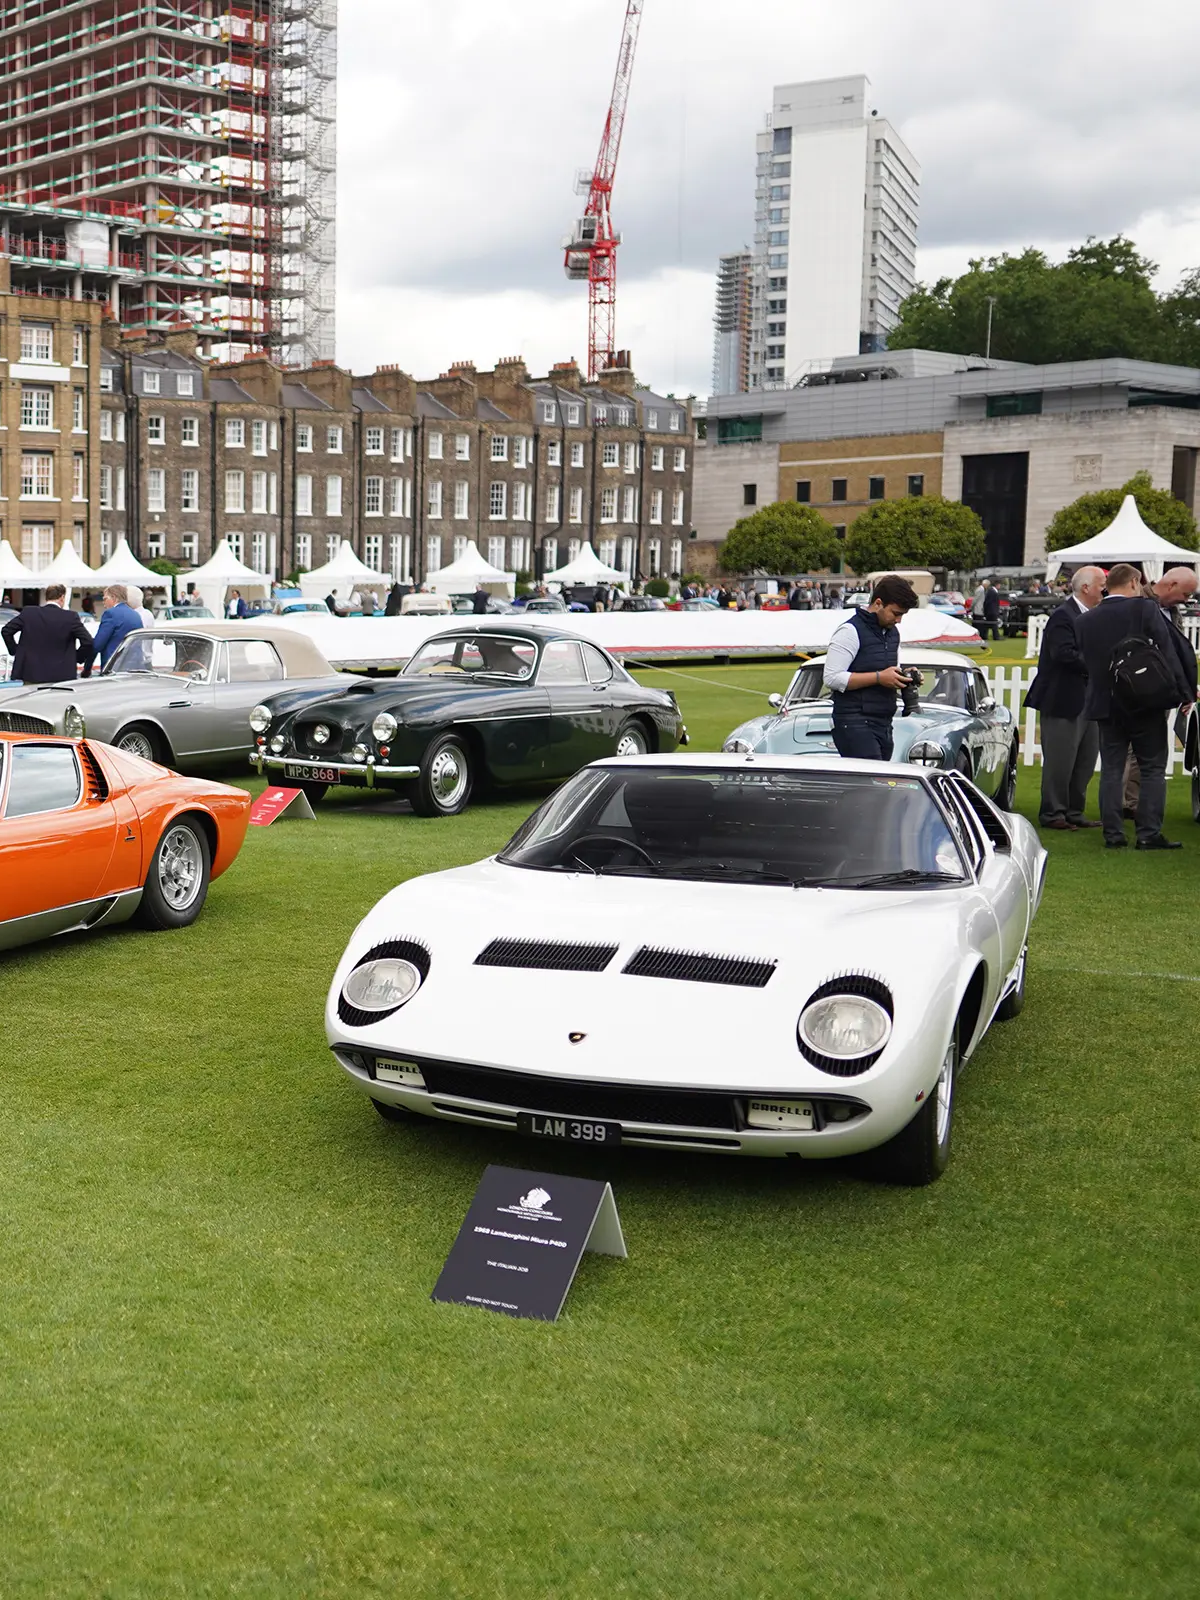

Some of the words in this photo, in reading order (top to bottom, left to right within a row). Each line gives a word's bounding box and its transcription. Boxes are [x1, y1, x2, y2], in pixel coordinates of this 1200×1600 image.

[288, 765, 309, 778] WPC
[312, 768, 334, 780] 868
[377, 1062, 422, 1074] CARELL
[751, 1102, 812, 1116] CARELLO
[531, 1117, 566, 1137] LAM
[570, 1122, 606, 1141] 399
[490, 1229, 530, 1241] Lamborghini
[530, 1236, 549, 1245] Miura
[549, 1239, 567, 1248] P400
[497, 1262, 517, 1270] ITALIAN
[501, 1302, 518, 1310] TOUCH
